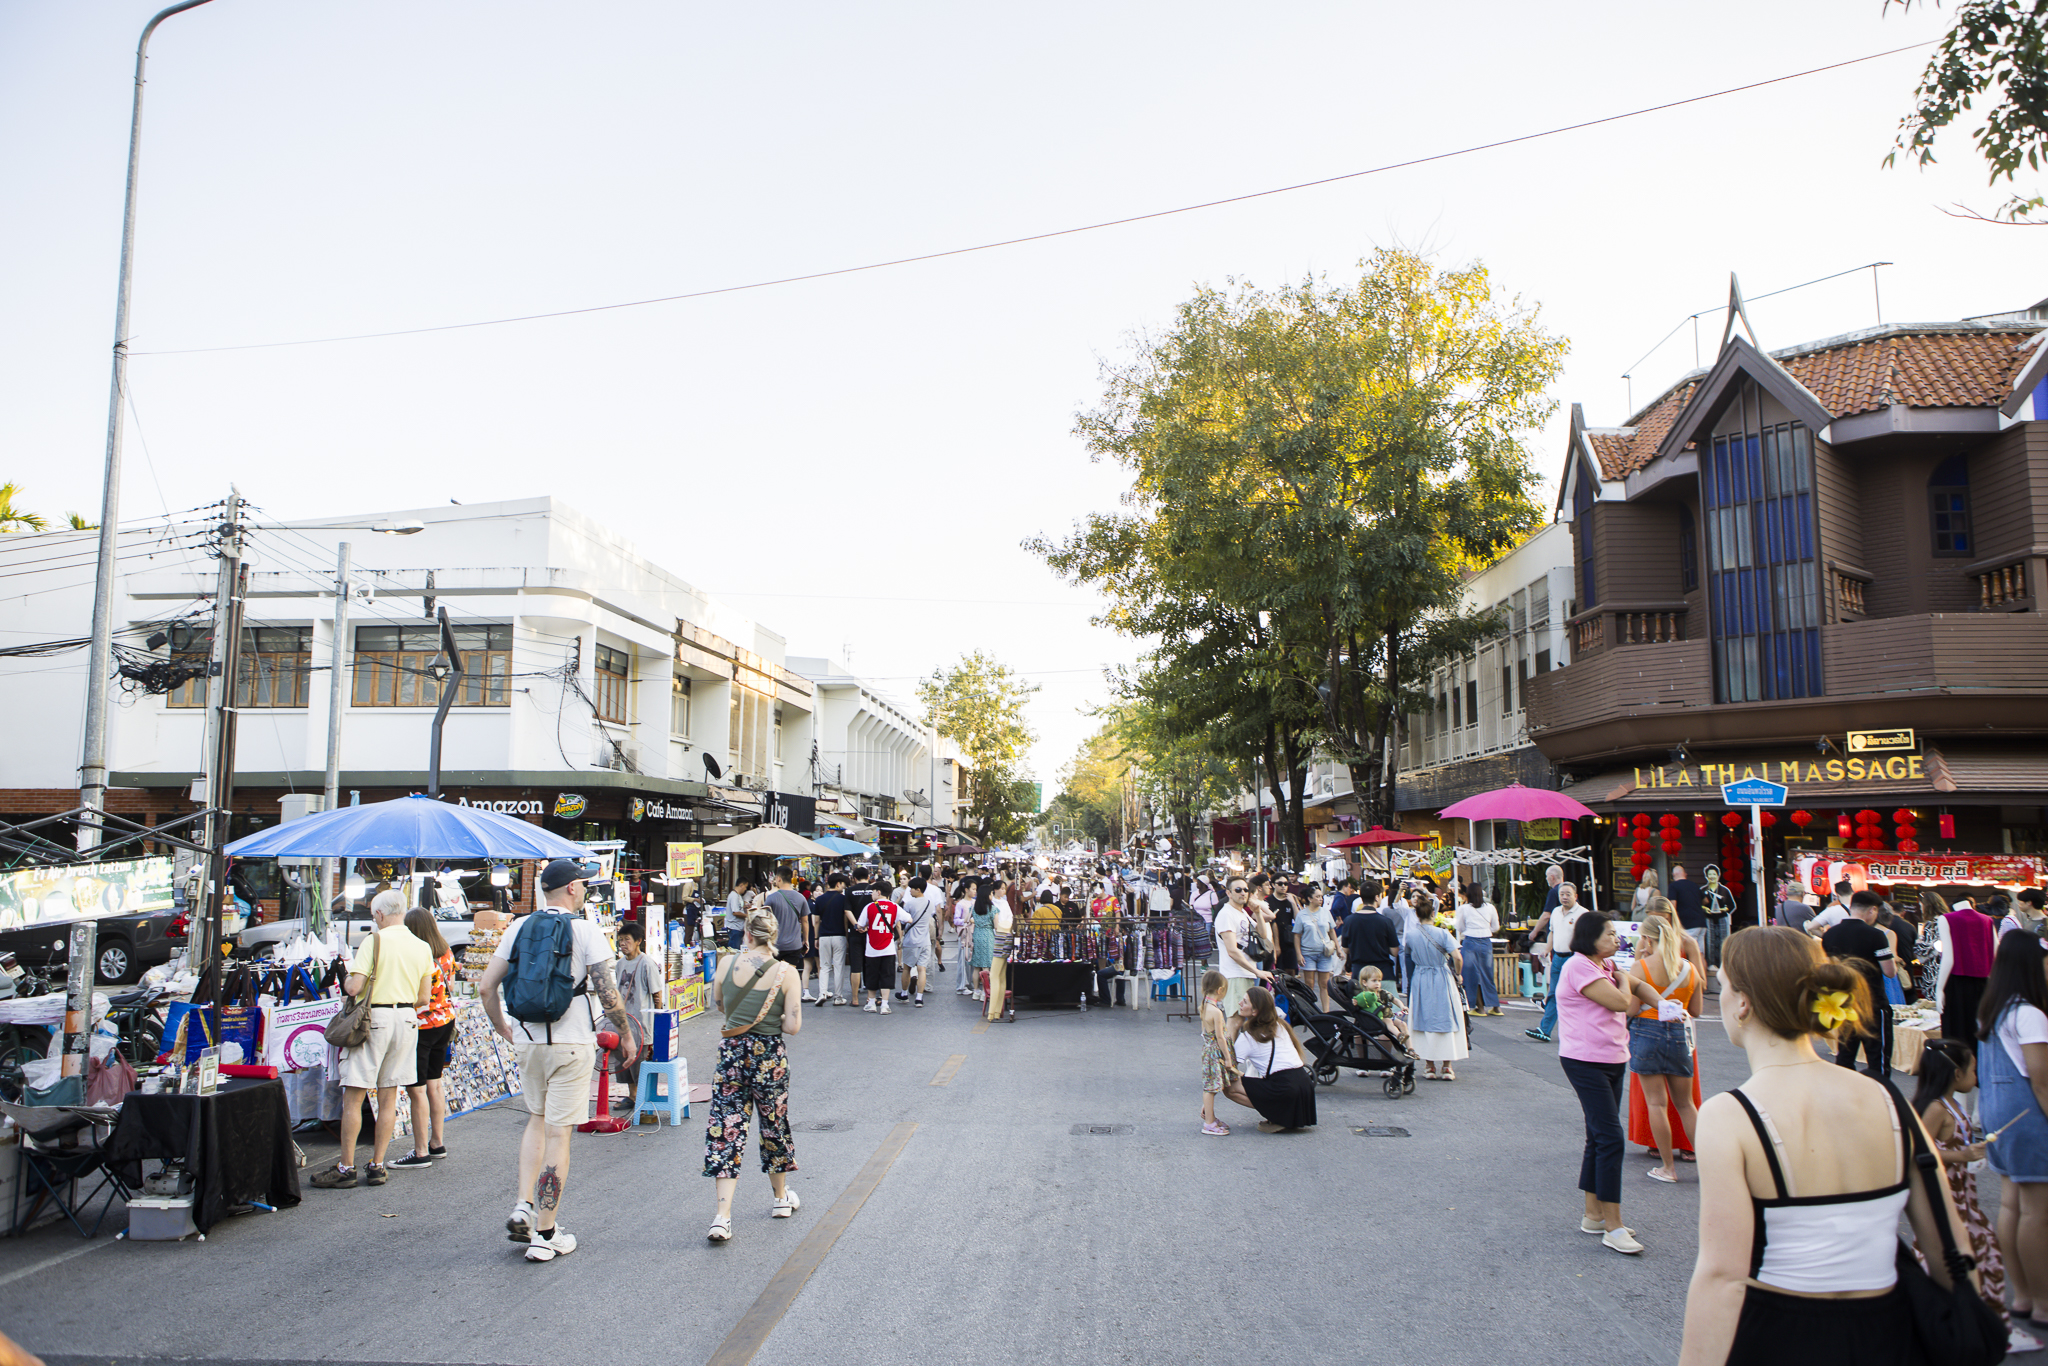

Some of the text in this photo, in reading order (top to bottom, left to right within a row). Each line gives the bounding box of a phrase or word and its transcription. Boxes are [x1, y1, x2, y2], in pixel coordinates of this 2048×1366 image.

[1700, 763, 1768, 785] THAI
[1780, 755, 1925, 783] MASSAGE
[646, 799, 664, 819] Café
[665, 803, 693, 821] Amazon
[66, 863, 98, 878] brush
[99, 861, 132, 874] tattoo
[871, 912, 892, 934] 41
